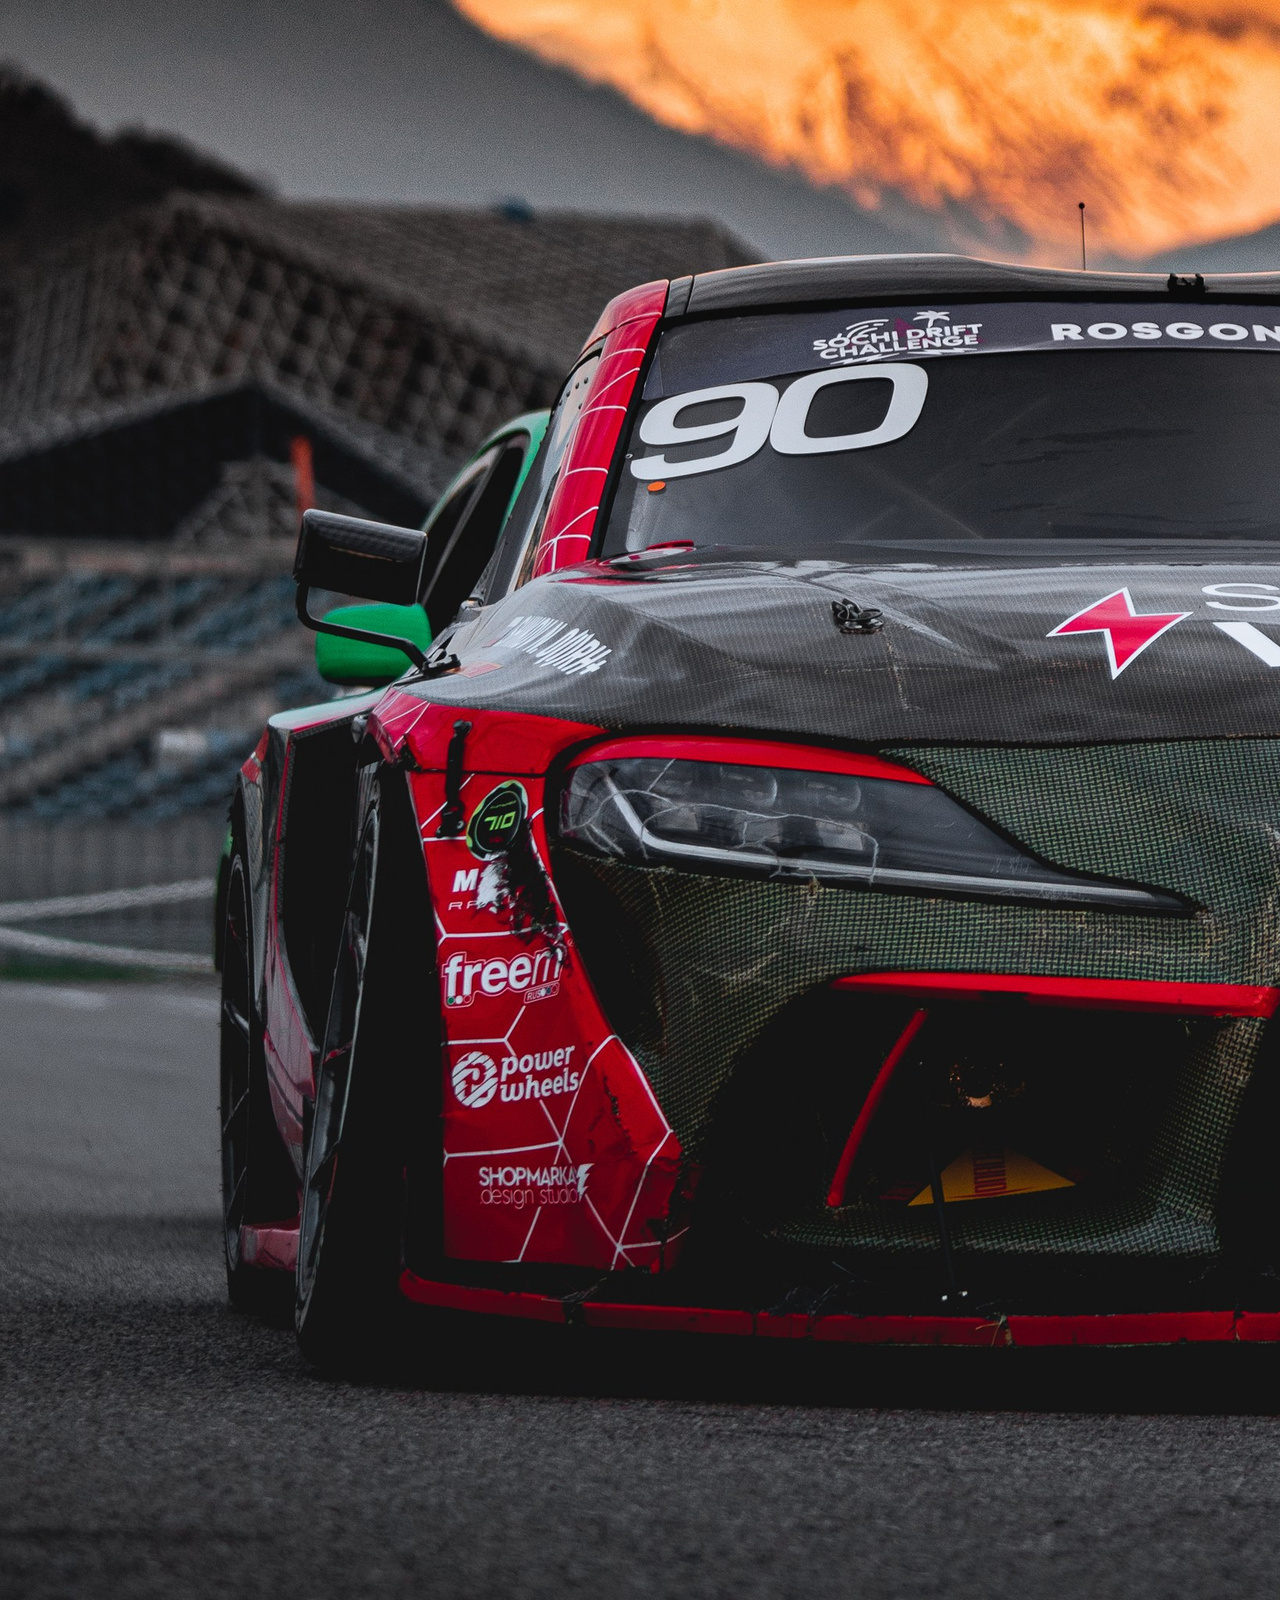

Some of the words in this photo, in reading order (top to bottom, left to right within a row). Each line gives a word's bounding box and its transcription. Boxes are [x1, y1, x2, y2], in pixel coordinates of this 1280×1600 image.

[813, 331, 899, 351] SOCHI
[906, 323, 983, 342] DRIFT
[820, 334, 979, 360] CHALLENGE
[629, 362, 930, 481] 90
[444, 948, 563, 997] freem
[501, 1045, 576, 1082] power
[500, 1067, 579, 1102] wheels
[479, 1166, 577, 1186] SHOPMARKA
[480, 1186, 535, 1209] design
[540, 1186, 578, 1204] studio
